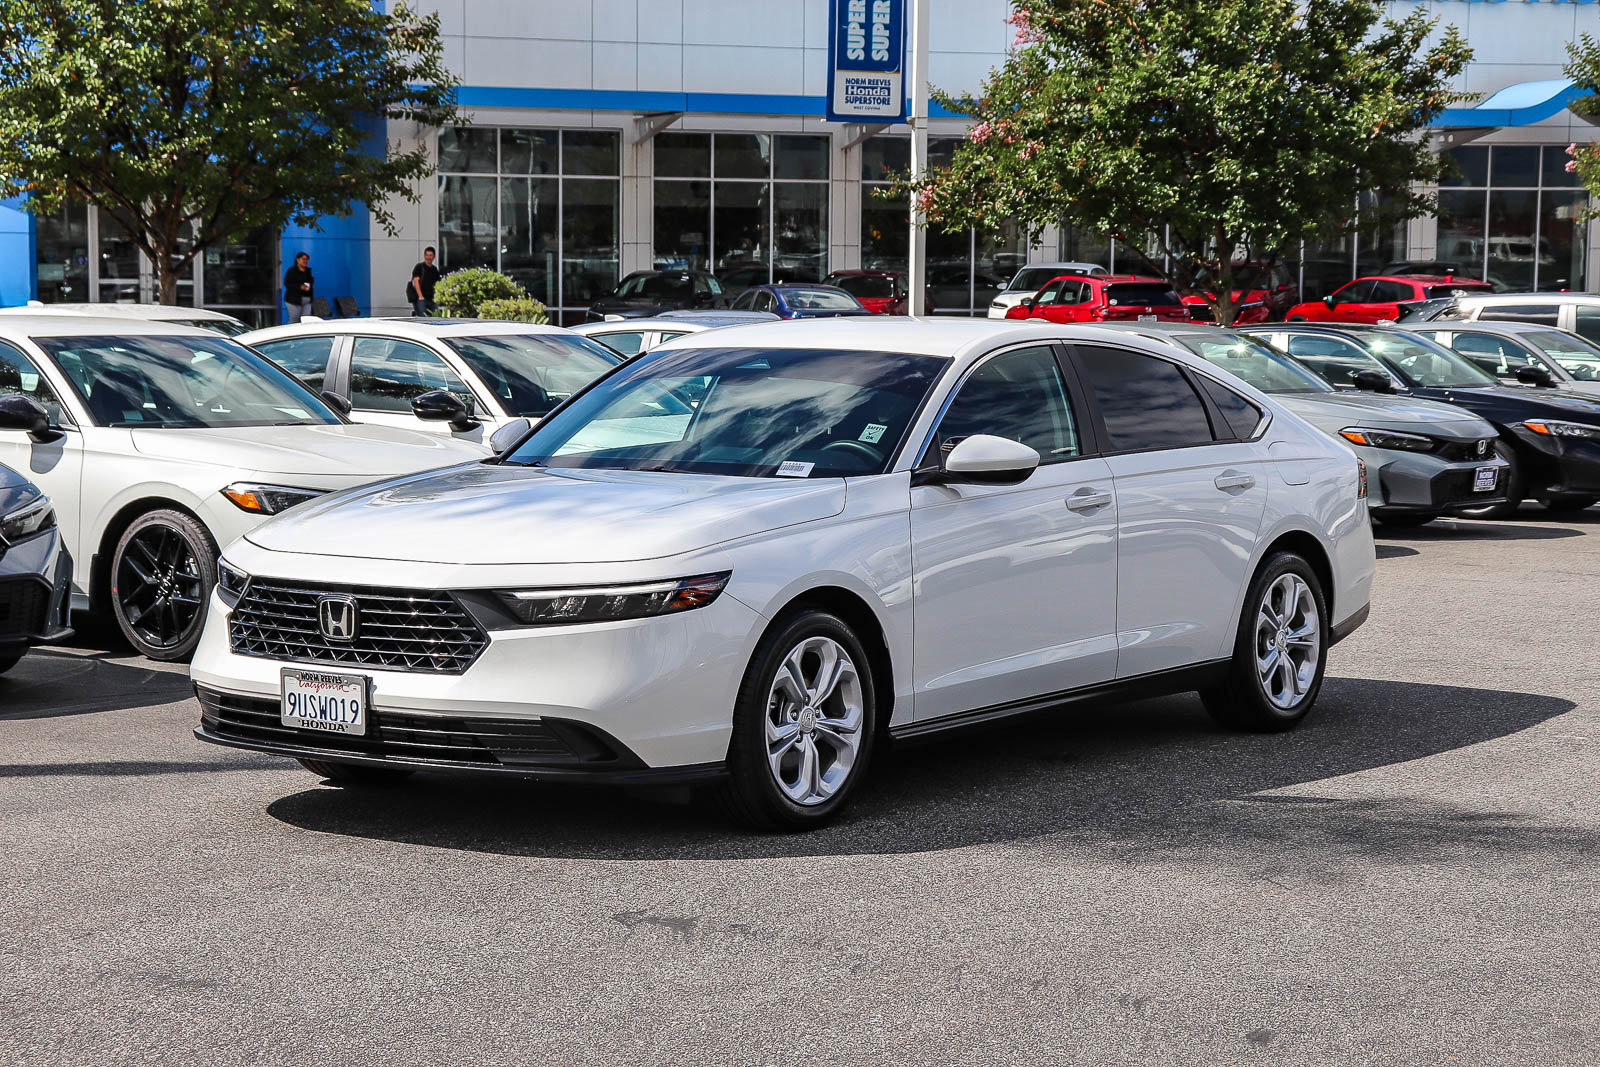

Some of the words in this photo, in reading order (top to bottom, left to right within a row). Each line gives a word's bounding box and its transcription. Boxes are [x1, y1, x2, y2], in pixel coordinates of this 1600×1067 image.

[847, 0, 866, 60] SUPER
[871, 0, 890, 61] SUPER
[847, 86, 889, 95] Honda
[845, 95, 891, 105] SUPERSTORE
[300, 672, 320, 682] NORM
[320, 674, 342, 684] REEVES
[288, 691, 359, 724] 9USW019
[301, 720, 345, 732] HONDA
